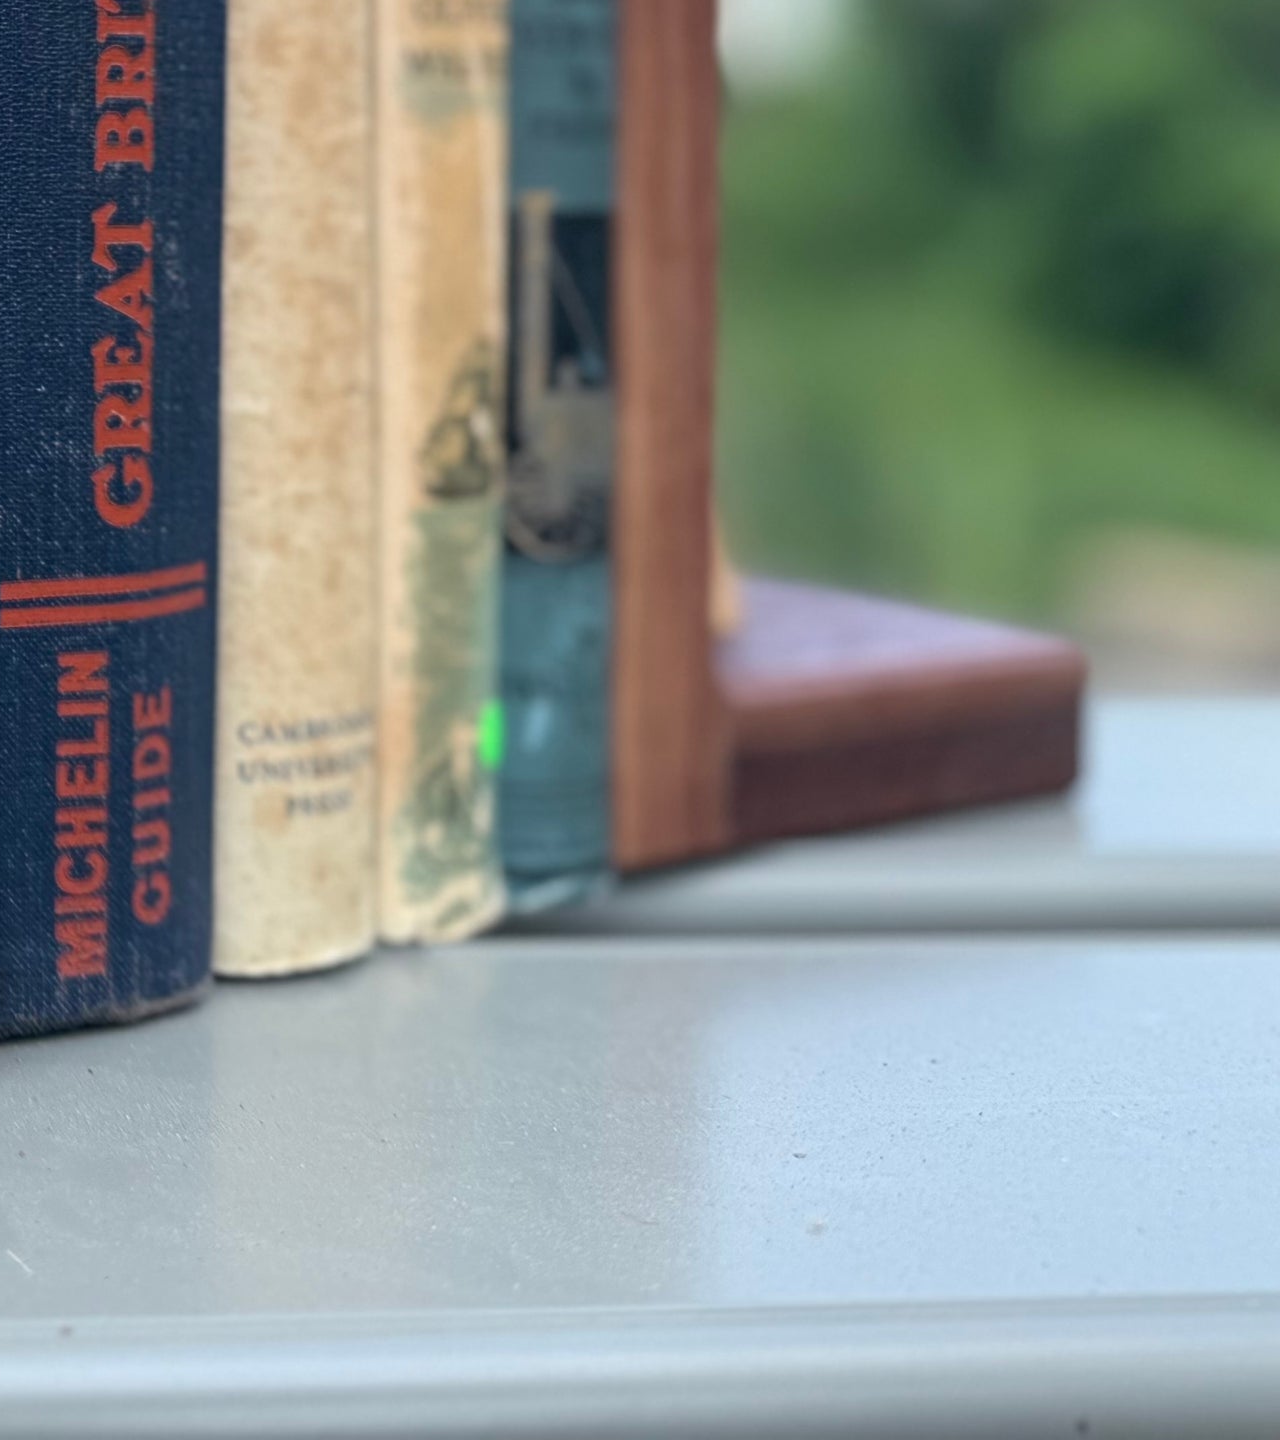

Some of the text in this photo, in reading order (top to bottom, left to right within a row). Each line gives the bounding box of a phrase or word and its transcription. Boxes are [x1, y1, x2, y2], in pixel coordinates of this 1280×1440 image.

[92, 202, 154, 528] GREAT
[55, 651, 111, 978] MICHELIN
[132, 685, 173, 925] GUIDE
